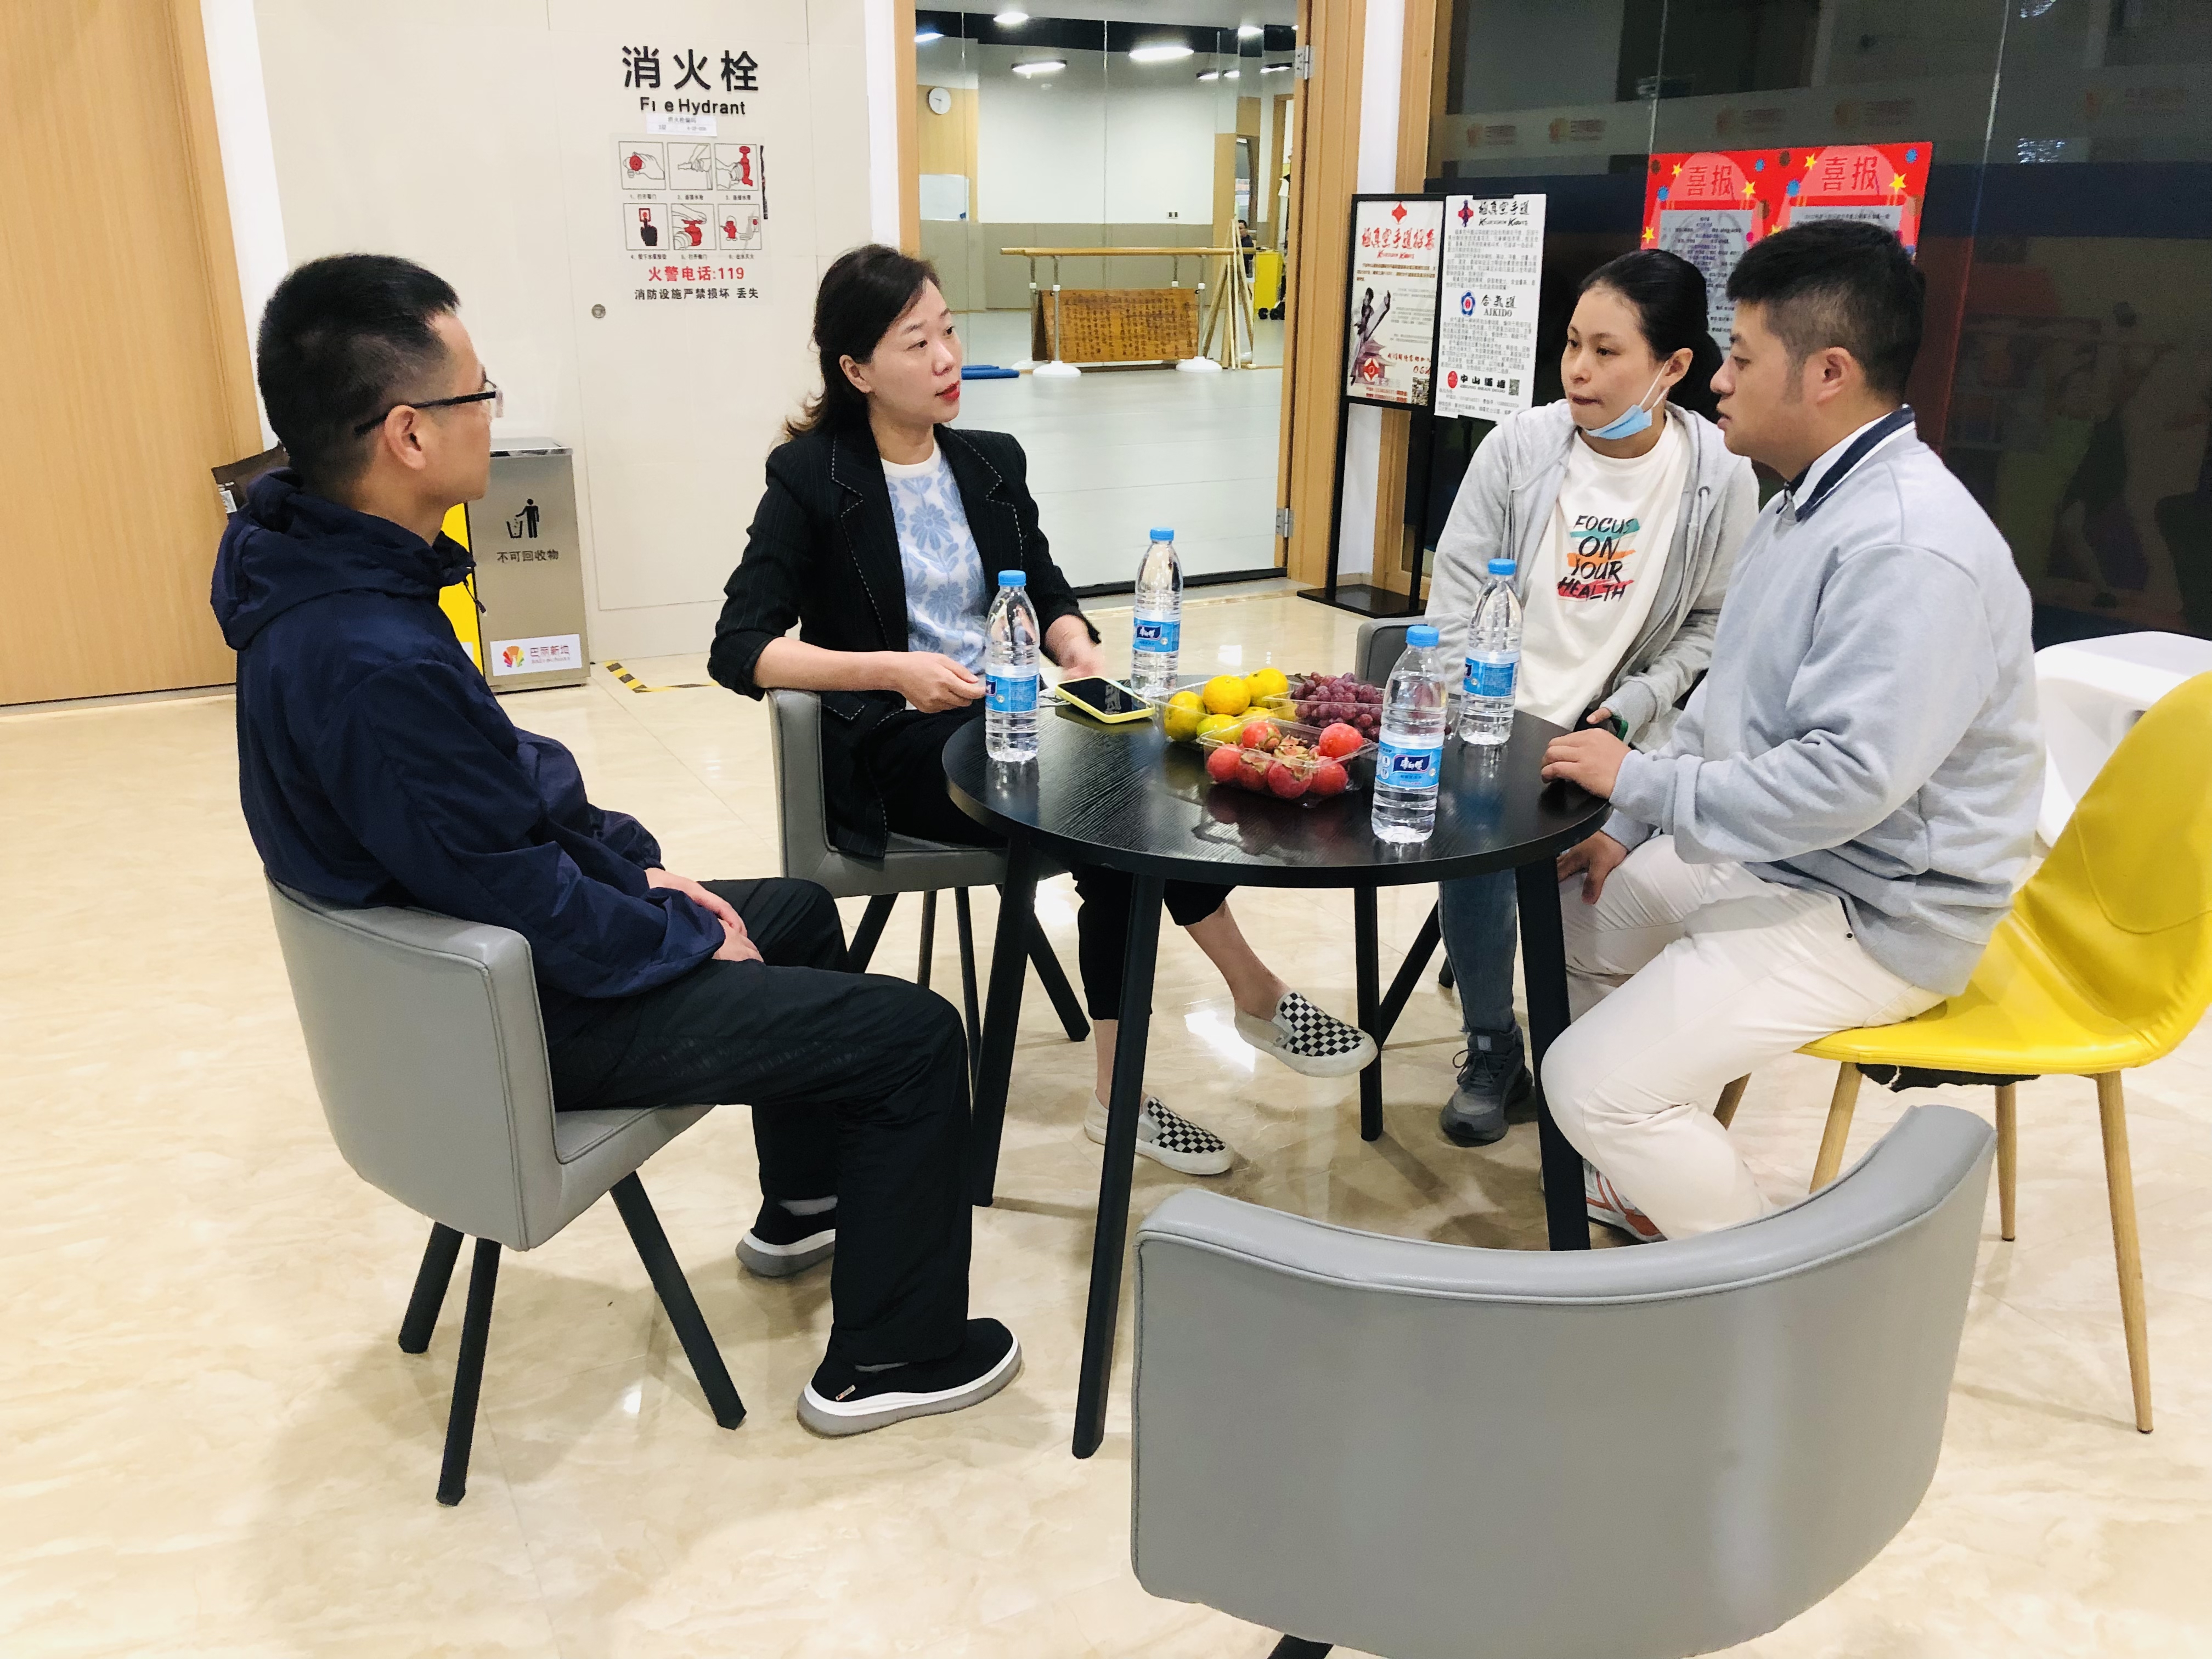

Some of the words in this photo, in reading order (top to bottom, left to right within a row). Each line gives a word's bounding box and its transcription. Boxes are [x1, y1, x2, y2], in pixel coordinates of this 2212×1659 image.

[622, 46, 758, 92] 消火栓
[679, 98, 746, 116] Hydrant
[1686, 165, 1735, 200] 喜报
[1822, 156, 1880, 195] 喜报
[634, 288, 730, 300] 消防设施严禁损坏
[1483, 308, 1513, 317] AIKIDO
[1573, 515, 1635, 534] FOCUS
[496, 549, 559, 563] 不可回收物
[1578, 535, 1621, 560] ON
[1571, 556, 1623, 583] YOUR
[1557, 576, 1628, 602] HEALTH
